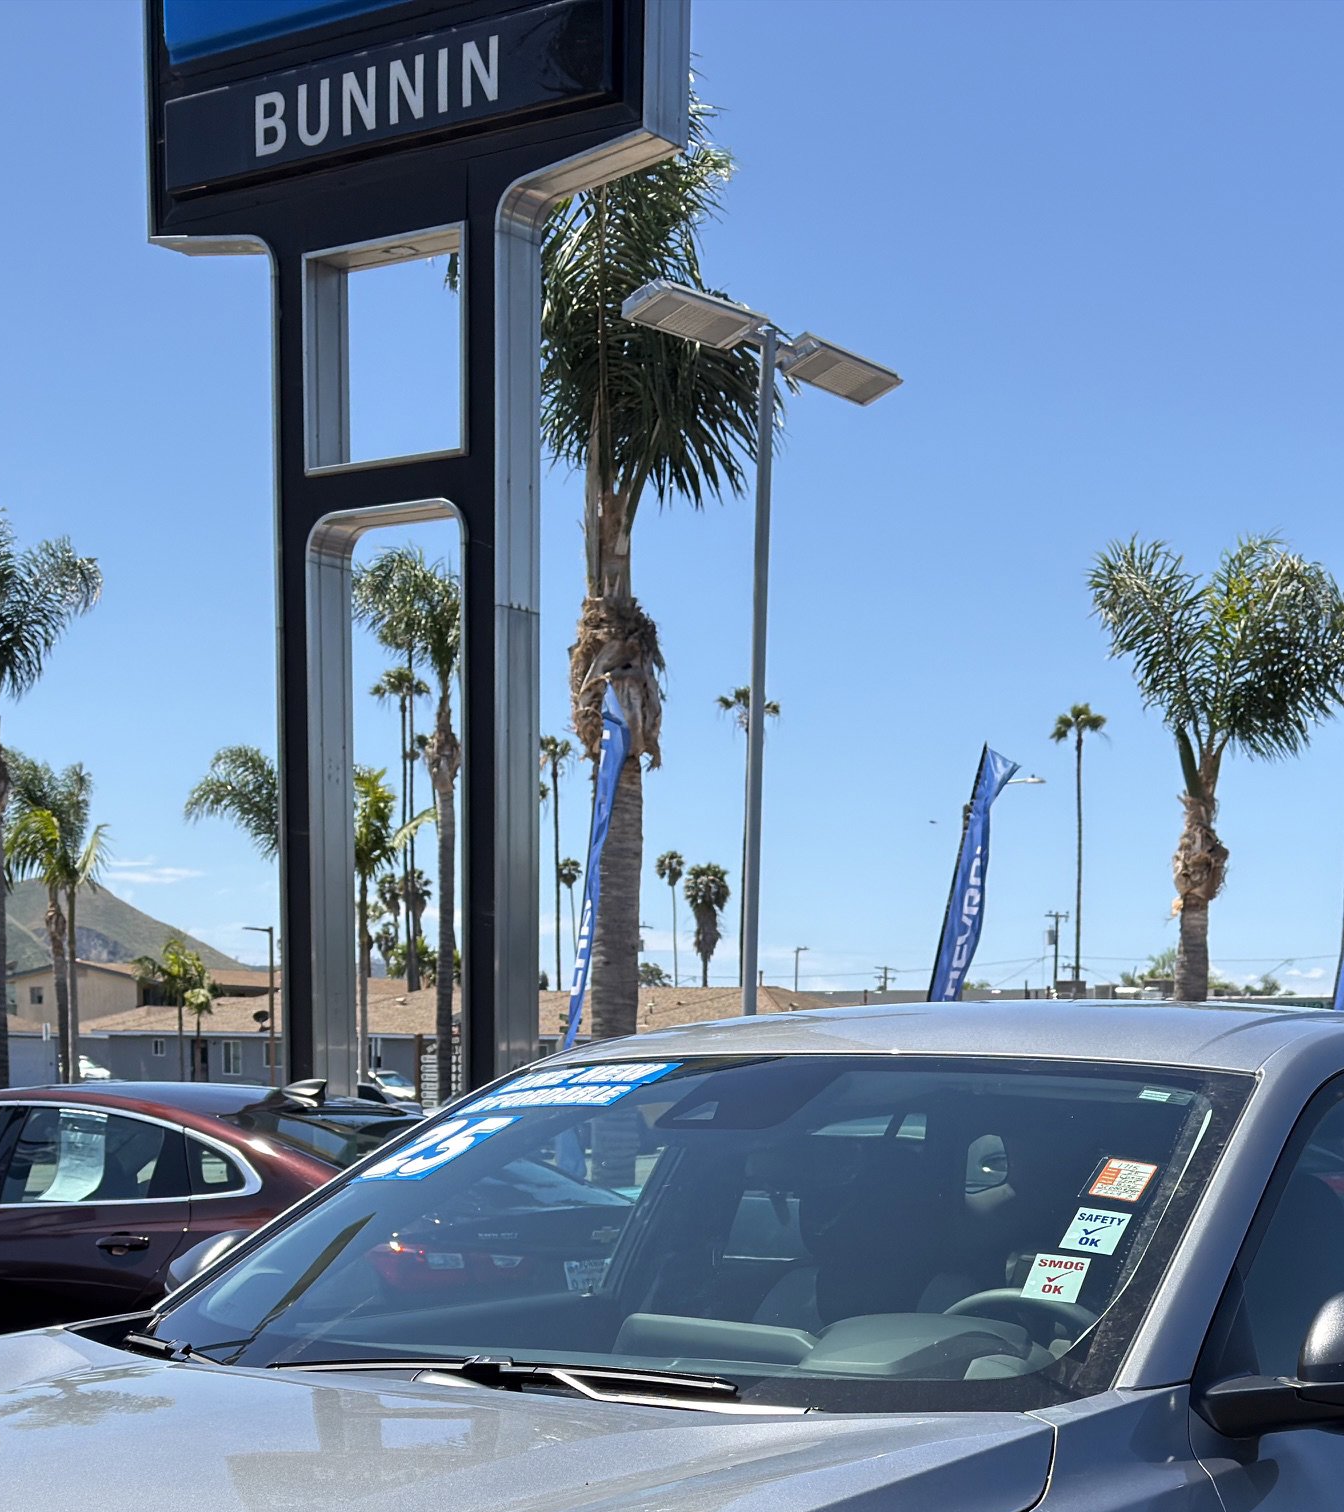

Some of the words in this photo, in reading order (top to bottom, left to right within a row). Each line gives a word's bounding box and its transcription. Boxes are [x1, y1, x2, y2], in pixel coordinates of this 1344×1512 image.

[255, 34, 500, 158] BUNNIN
[360, 1117, 516, 1179] 25
[1077, 1212, 1126, 1226] SAFETY
[1078, 1236, 1102, 1248] OK
[1038, 1258, 1086, 1272] SMOG
[1041, 1284, 1064, 1295] OK
